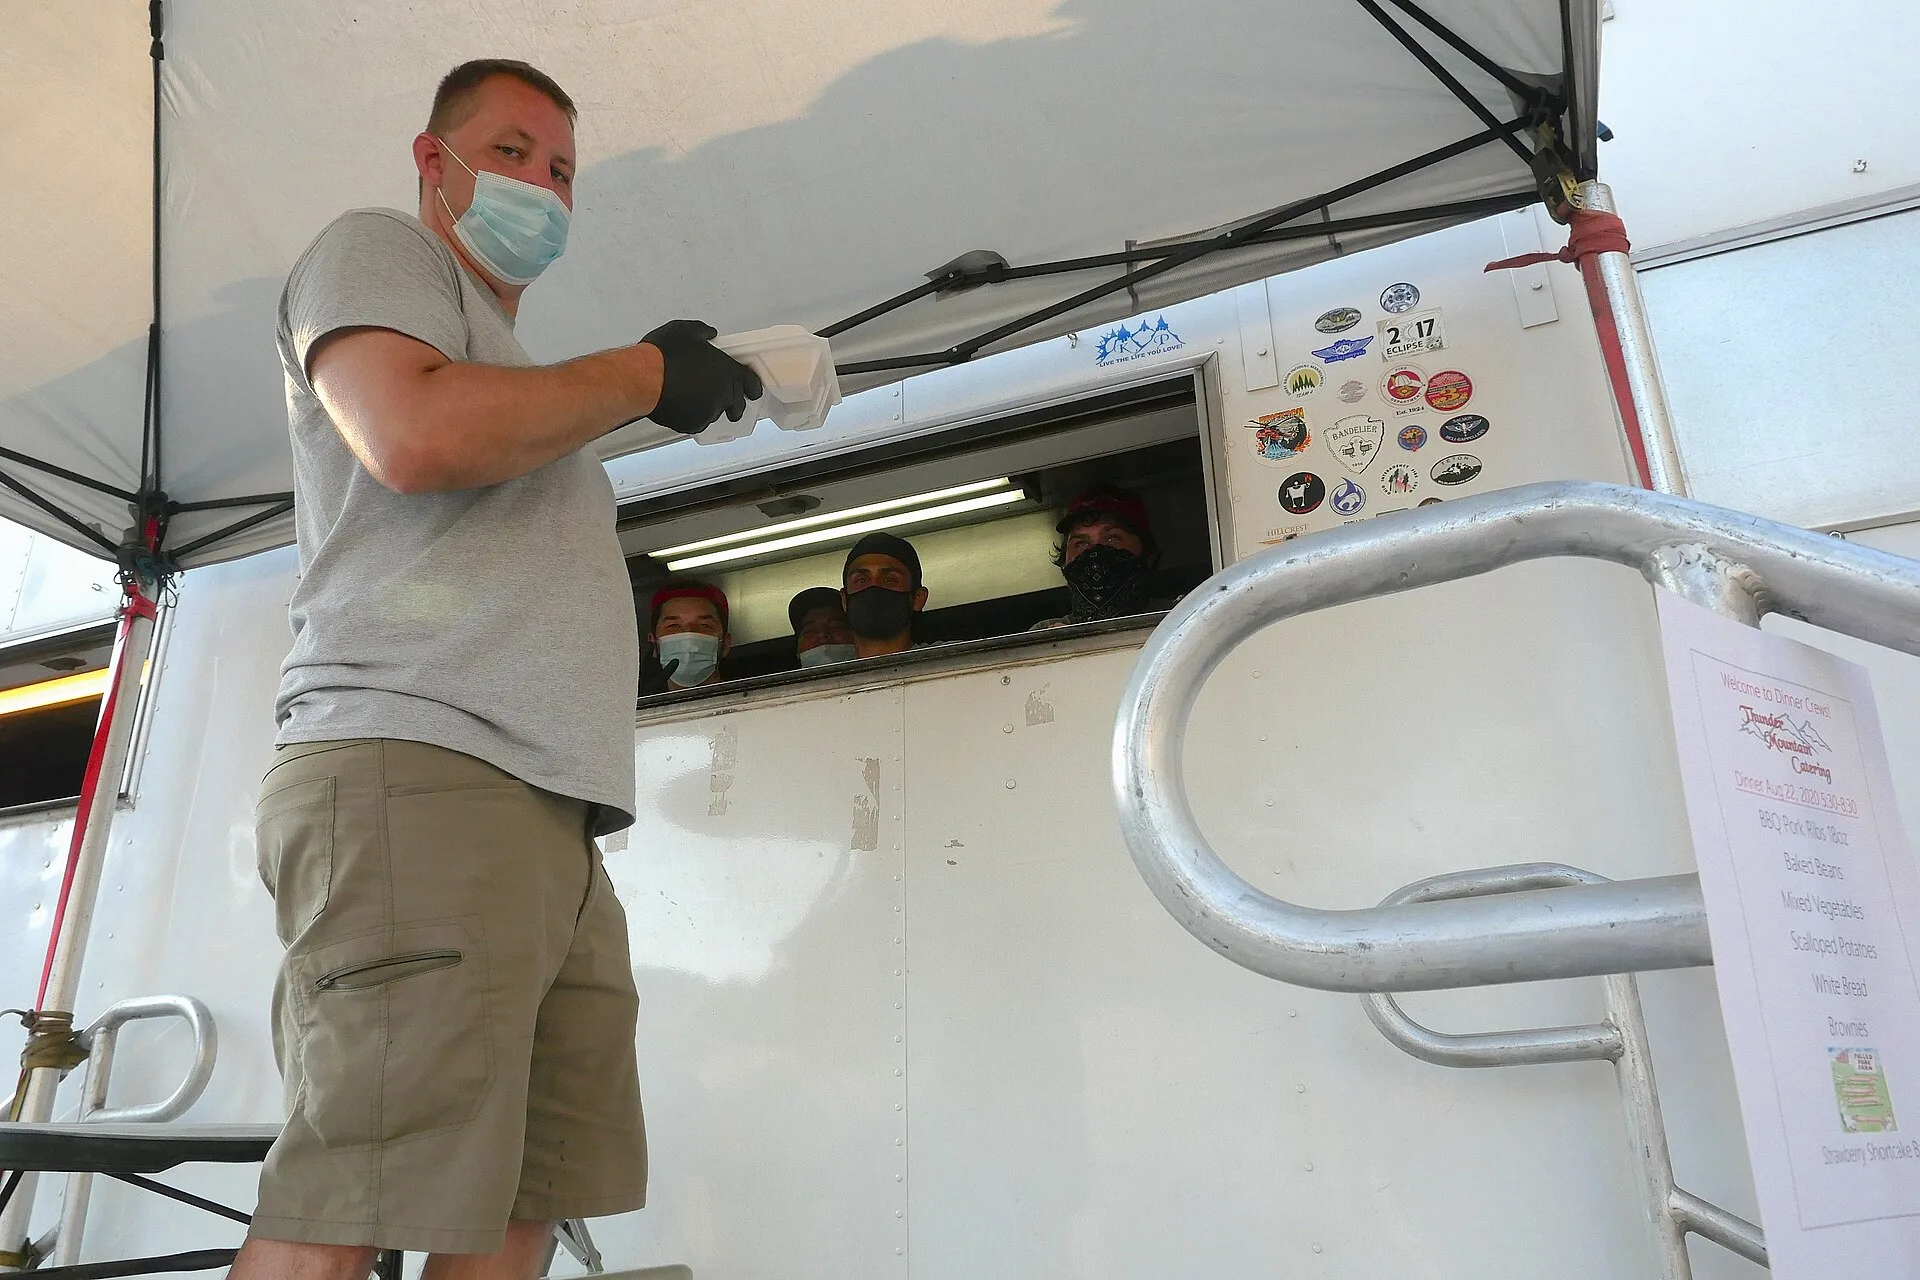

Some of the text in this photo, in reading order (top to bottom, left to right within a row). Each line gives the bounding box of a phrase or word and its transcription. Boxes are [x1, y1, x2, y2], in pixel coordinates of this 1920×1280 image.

[1099, 359, 1114, 367] LIVE
[1147, 348, 1161, 356] YOU
[1163, 344, 1183, 353] LOVE!
[1386, 340, 1424, 355] ECLIPSE
[1390, 392, 1423, 404] DEPARTMENT
[1332, 425, 1378, 441] BANDELIER
[1441, 456, 1469, 466] TETON
[1267, 523, 1309, 537] HILLCREST
[1720, 671, 1832, 718] Welcome to Dinner Crews!
[1739, 704, 1784, 729] Thunder
[1764, 731, 1813, 756] Mountain
[1791, 756, 1832, 785] Catering
[1734, 770, 1763, 791] Dinner
[1766, 779, 1784, 800] Aug
[1799, 786, 1820, 806] 2020
[1820, 792, 1858, 815] 5:30-8:30
[1758, 809, 1849, 846] BBQ Pork Ribs 18oz
[1783, 851, 1844, 880] Baked Beans
[1780, 889, 1865, 921] Mixed Vegetables
[1790, 930, 1878, 960] Scalloped Potatoes
[1811, 974, 1868, 997] White Bread
[1827, 1016, 1869, 1038] Brownies
[1866, 1140, 1913, 1161] Shortcake
